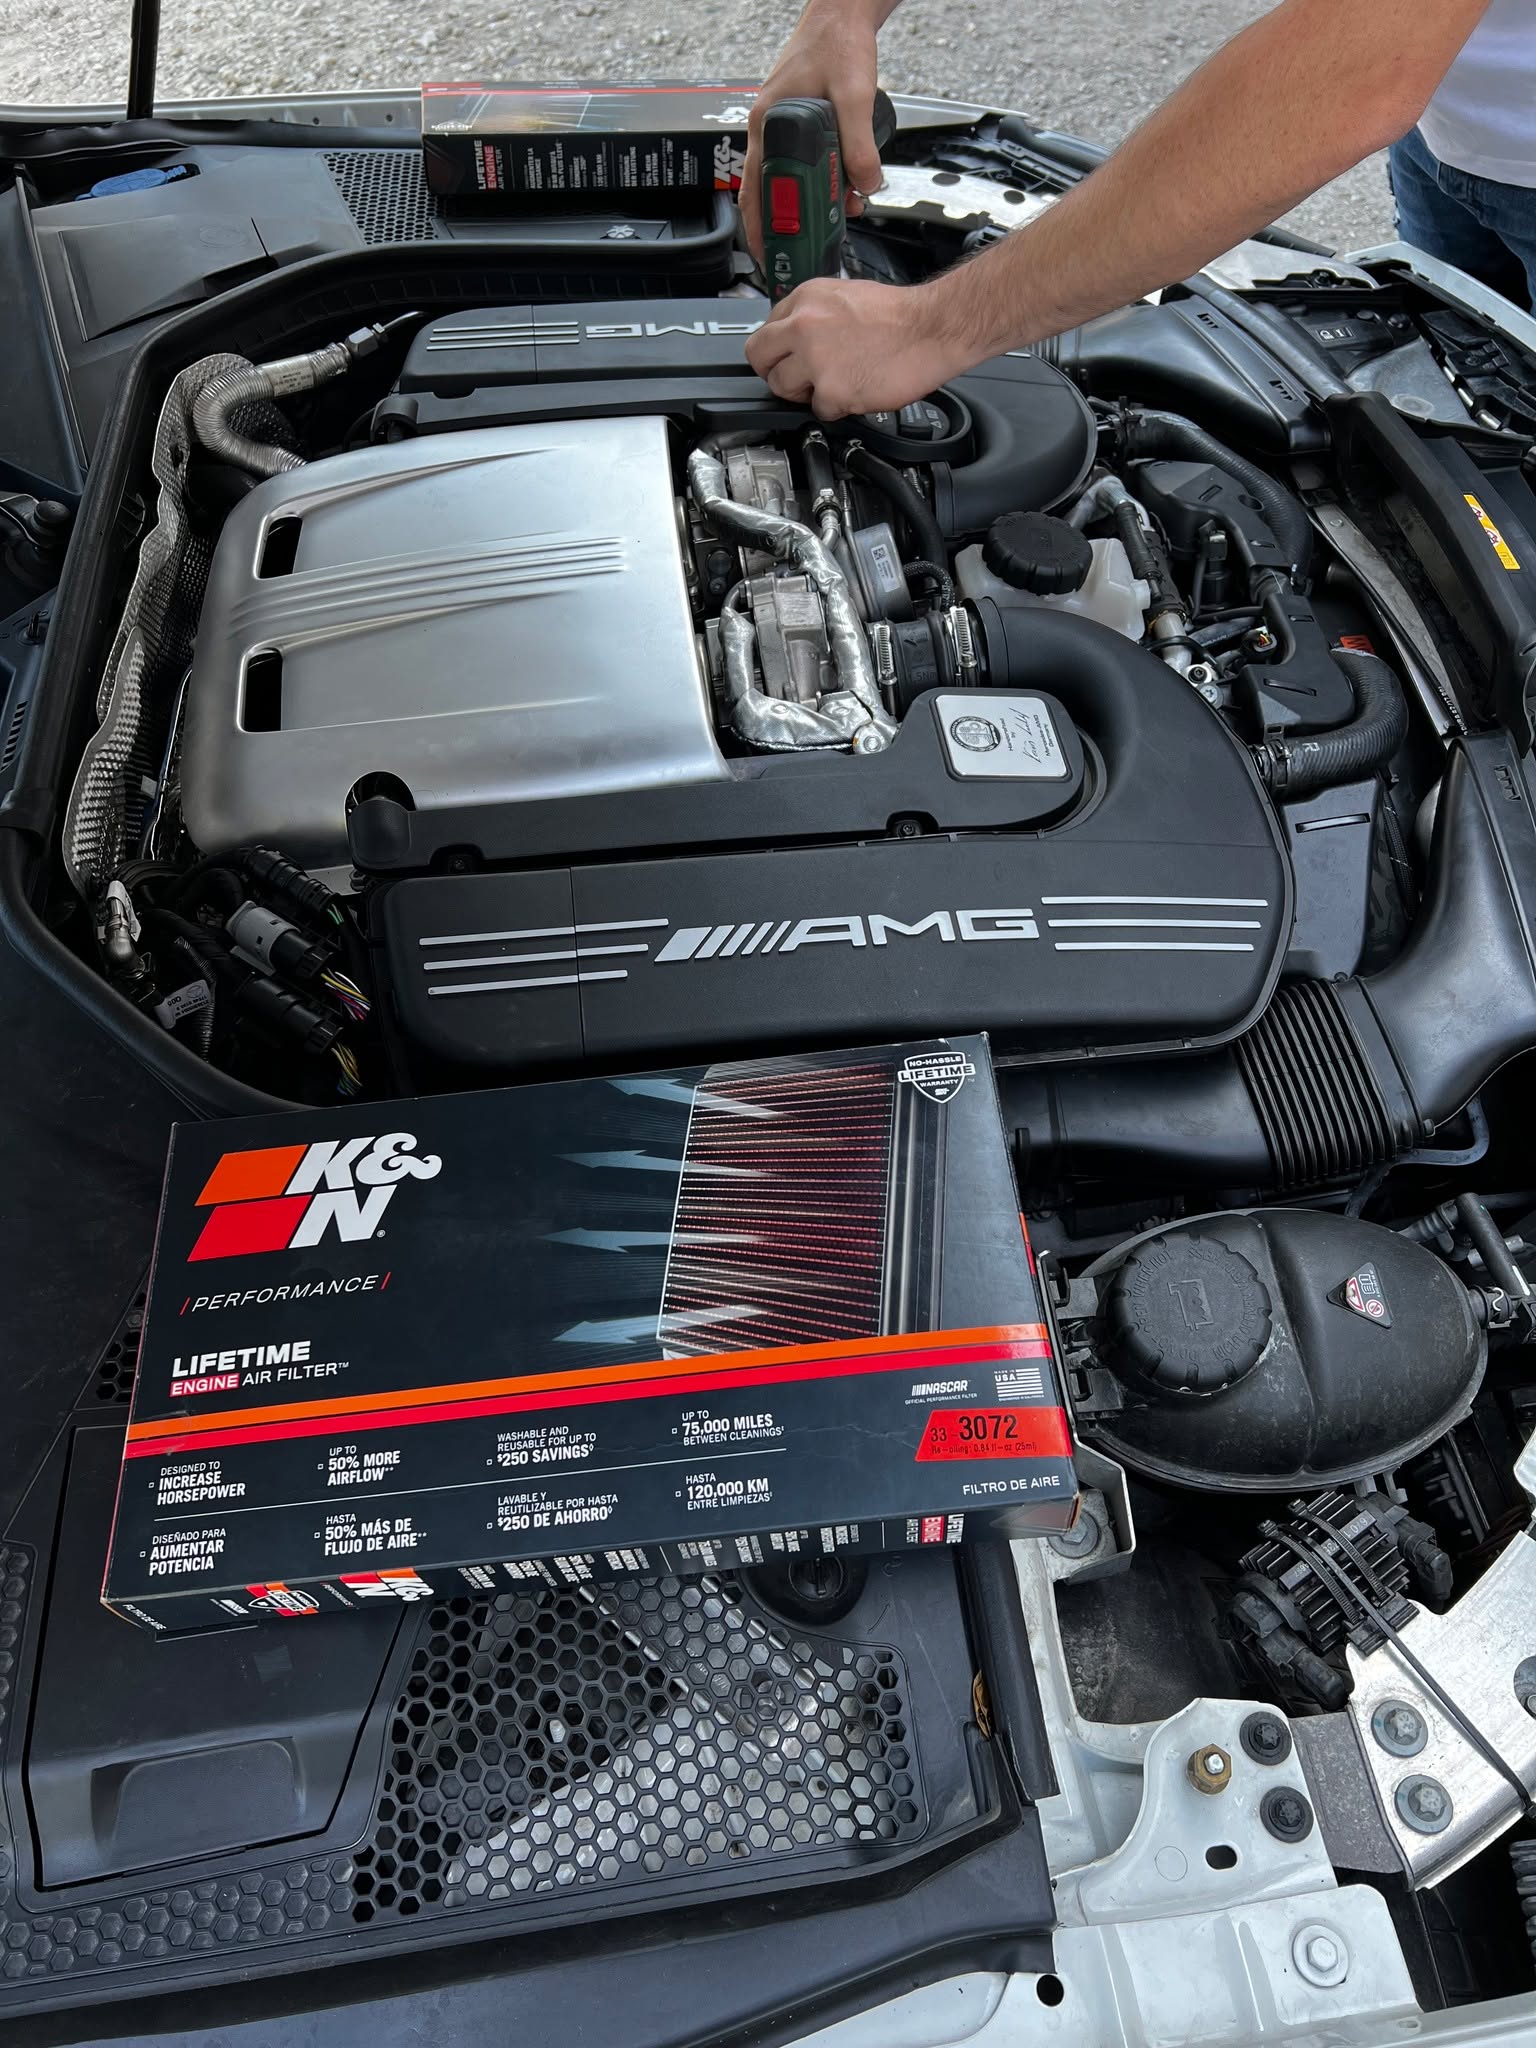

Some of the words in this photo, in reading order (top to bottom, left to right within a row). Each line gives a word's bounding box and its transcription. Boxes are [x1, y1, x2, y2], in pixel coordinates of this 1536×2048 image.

[474, 139, 486, 190] LIFETIME
[485, 146, 496, 189] ENGINE
[779, 908, 1040, 952] AMG
[909, 1056, 962, 1068] NO-HASSLE
[900, 1065, 973, 1081] LIFETIME
[920, 1079, 959, 1088] WARRANTY
[172, 1341, 311, 1378] LIFETIME
[171, 1374, 239, 1397] ENGINE
[242, 1370, 272, 1386] AIR
[925, 1379, 968, 1395] NASCAR
[994, 1373, 1016, 1382] USA
[682, 1411, 695, 1421] UP
[697, 1410, 709, 1419] TO
[682, 1418, 730, 1436] 75,000
[734, 1413, 773, 1431] MILES
[497, 1428, 547, 1442] WASHABLE
[549, 1426, 569, 1437] AND
[498, 1438, 546, 1452] REUSABLE
[548, 1435, 566, 1447] FOR
[569, 1434, 582, 1444] UP
[584, 1432, 596, 1442] TO
[683, 1432, 727, 1446] BETWEEN
[329, 1447, 342, 1456] UP
[345, 1445, 357, 1455] TO
[497, 1450, 529, 1467] $250
[160, 1462, 206, 1476] DESIGNED
[208, 1461, 220, 1470] TO
[328, 1456, 360, 1471] 50%
[363, 1450, 400, 1467] MORE
[159, 1471, 222, 1491] INCREASE
[686, 1472, 717, 1485] HASTA
[963, 1481, 1008, 1496] FILTRO
[1010, 1479, 1027, 1491] DE
[1031, 1475, 1060, 1489] AIRE
[157, 1483, 246, 1505] HORSEPOWER
[687, 1480, 744, 1500] 120,000
[747, 1477, 769, 1493] KM
[498, 1493, 538, 1506] LAVABLE
[541, 1491, 547, 1501] Y
[498, 1500, 563, 1516] REUTILIZABLE
[566, 1497, 585, 1508] POR
[587, 1494, 618, 1506] HASTA
[687, 1497, 719, 1511] ENTRE
[325, 1524, 358, 1540] 50%
[361, 1518, 391, 1537] MÁS
[395, 1517, 412, 1533] DE
[326, 1513, 357, 1525] HASTA
[497, 1515, 530, 1532] $250
[533, 1513, 551, 1528] DE
[152, 1531, 200, 1545] DISEÑADO
[201, 1528, 226, 1539] PARA
[324, 1538, 363, 1556] FLUJO
[366, 1536, 384, 1552] DE
[150, 1539, 224, 1560] AUMENTAR
[149, 1556, 215, 1576] POTENCIA
